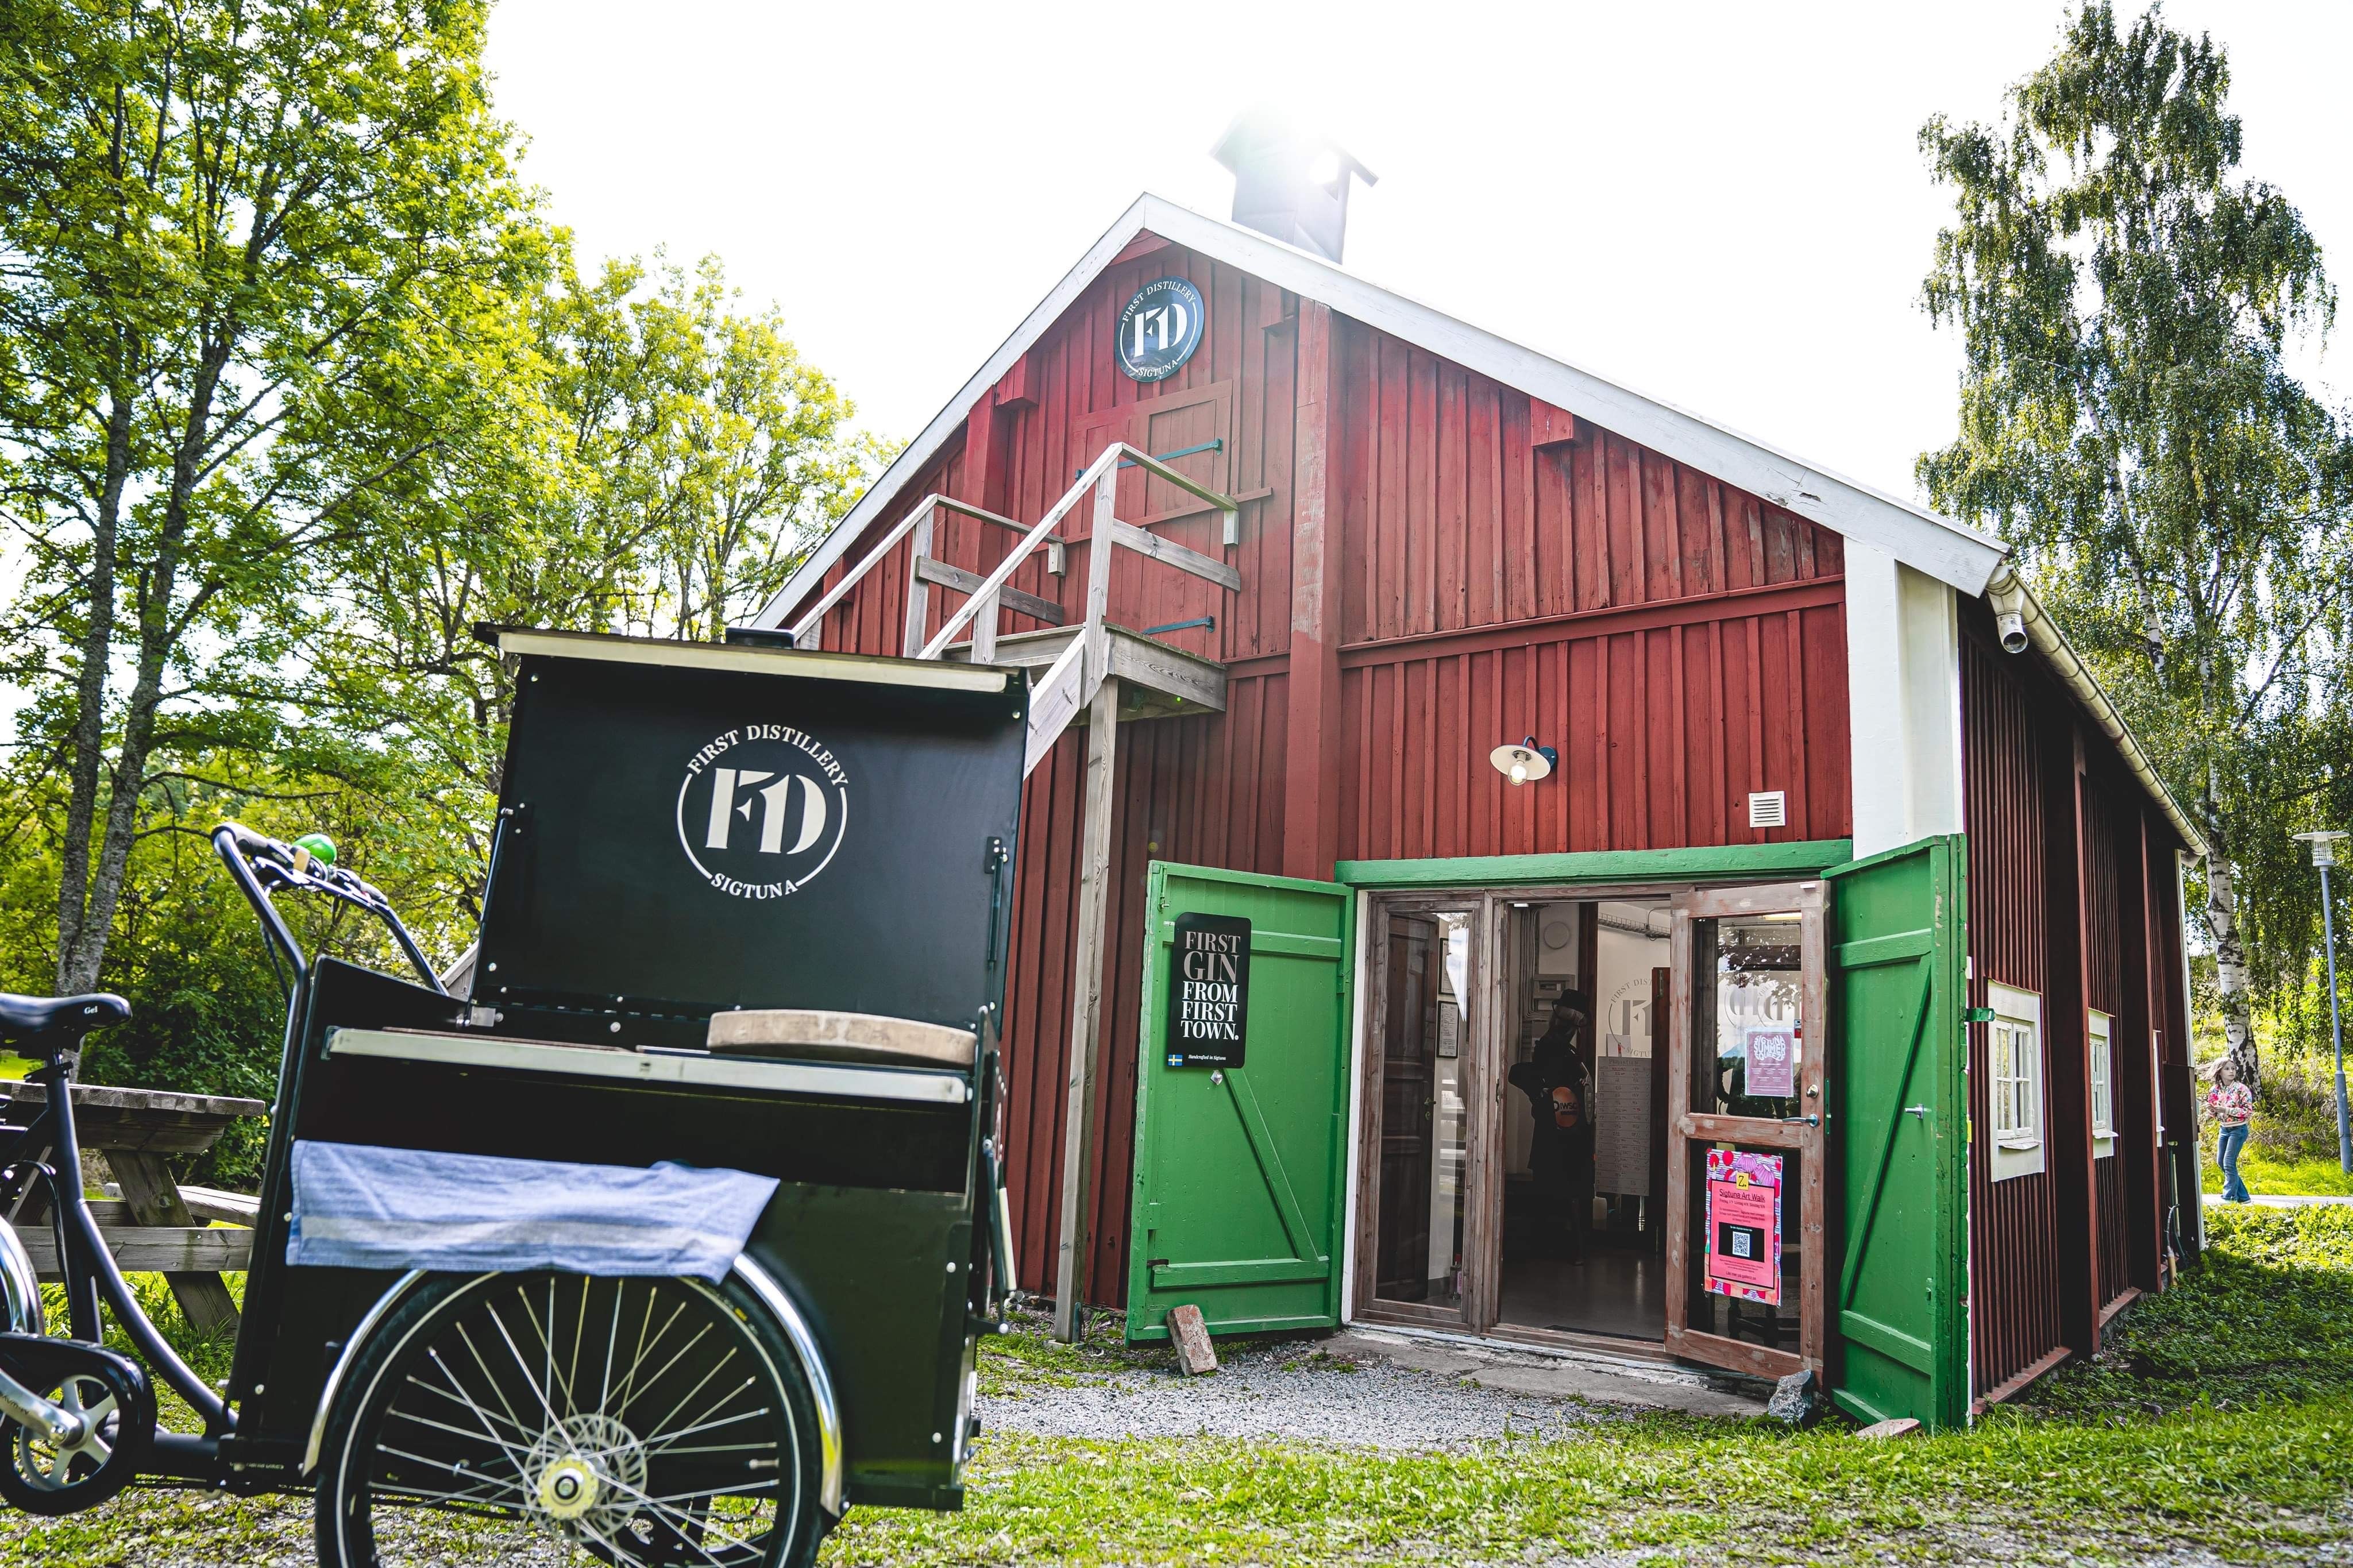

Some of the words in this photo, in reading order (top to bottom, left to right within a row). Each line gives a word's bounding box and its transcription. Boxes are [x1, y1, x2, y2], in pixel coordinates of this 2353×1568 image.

[1123, 292, 1144, 322] FIRST
[1146, 281, 1196, 303] DISTILLERY
[1137, 359, 1178, 377] SIGTUNA
[687, 729, 739, 775] FIRST
[746, 724, 849, 786] DISTILLERY
[711, 872, 799, 899] SIGTUNA
[1185, 931, 1241, 953] FIRST
[1183, 951, 1240, 983] GIN
[1182, 980, 1239, 1003] FROM
[1611, 982, 1631, 1003] FIRST
[84, 1006, 98, 1014] Gel
[1181, 1001, 1237, 1022] FIRST
[1181, 1020, 1239, 1040] TOWN.
[1754, 1035, 1785, 1045] SIGTUNA
[1754, 1043, 1785, 1056] SUMMER
[1719, 1188, 1741, 1198] Sigtuna
[1752, 1194, 1765, 1202] Walk
